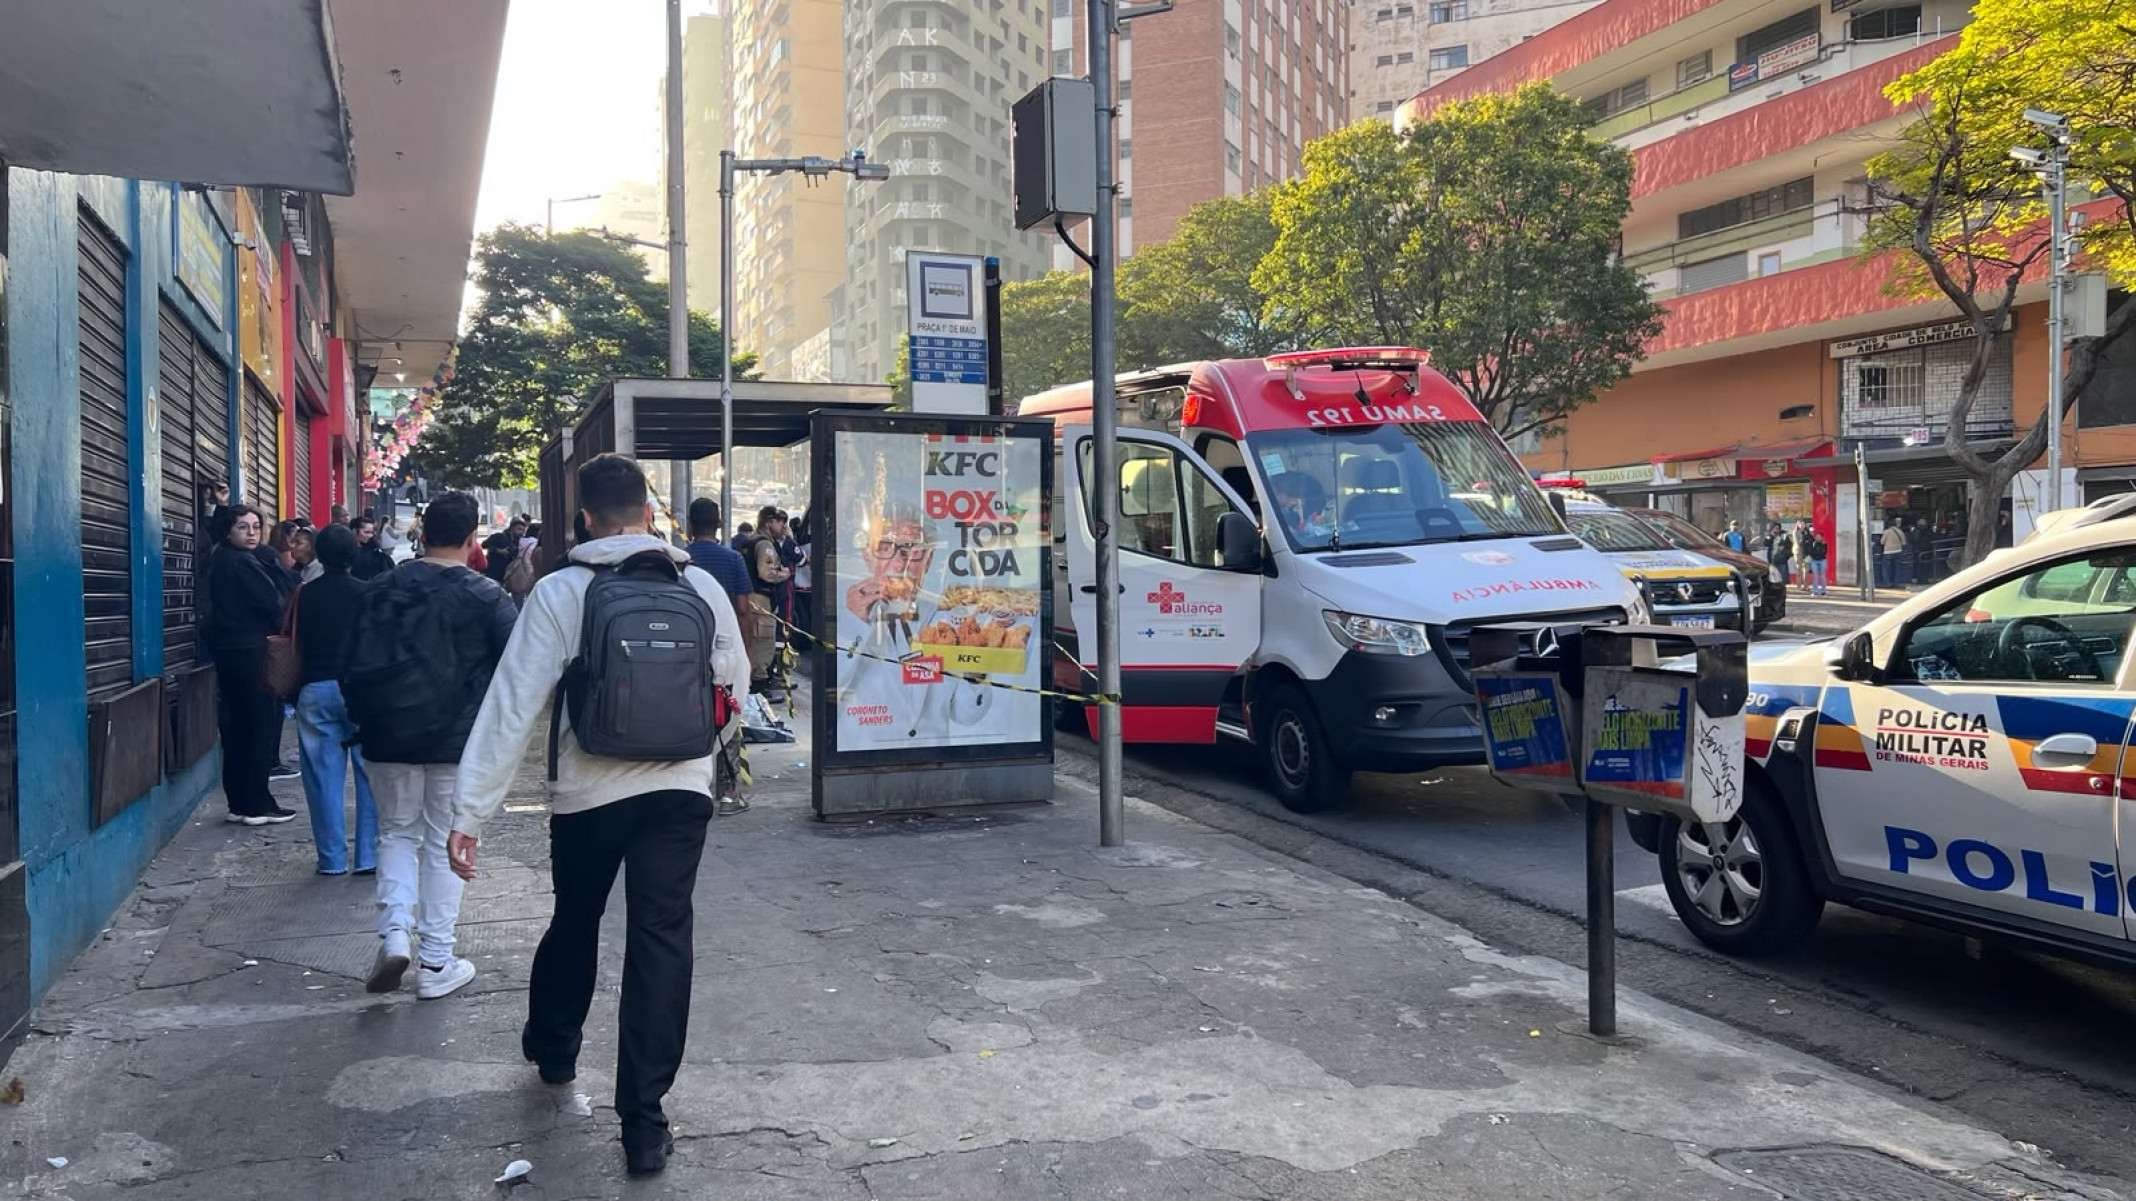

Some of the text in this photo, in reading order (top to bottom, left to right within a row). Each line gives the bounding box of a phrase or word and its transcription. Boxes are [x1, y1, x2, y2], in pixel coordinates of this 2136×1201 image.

[949, 324, 960, 334] DE
[960, 325, 977, 335] MAIO
[1883, 330, 1913, 343] CIDADE
[1916, 328, 1929, 336] DE
[1908, 326, 1978, 345] COMERCIA
[925, 451, 999, 477] KFC
[925, 490, 998, 520] BOX
[955, 522, 1019, 548] TOR
[948, 549, 1021, 577] CIDA
[1174, 603, 1223, 616] aliança
[957, 654, 982, 664] KFC
[1875, 732, 1987, 759] MILITAR
[1876, 752, 1989, 771] DE MINAS GERAIS
[1884, 825, 2136, 920] POLÍ
